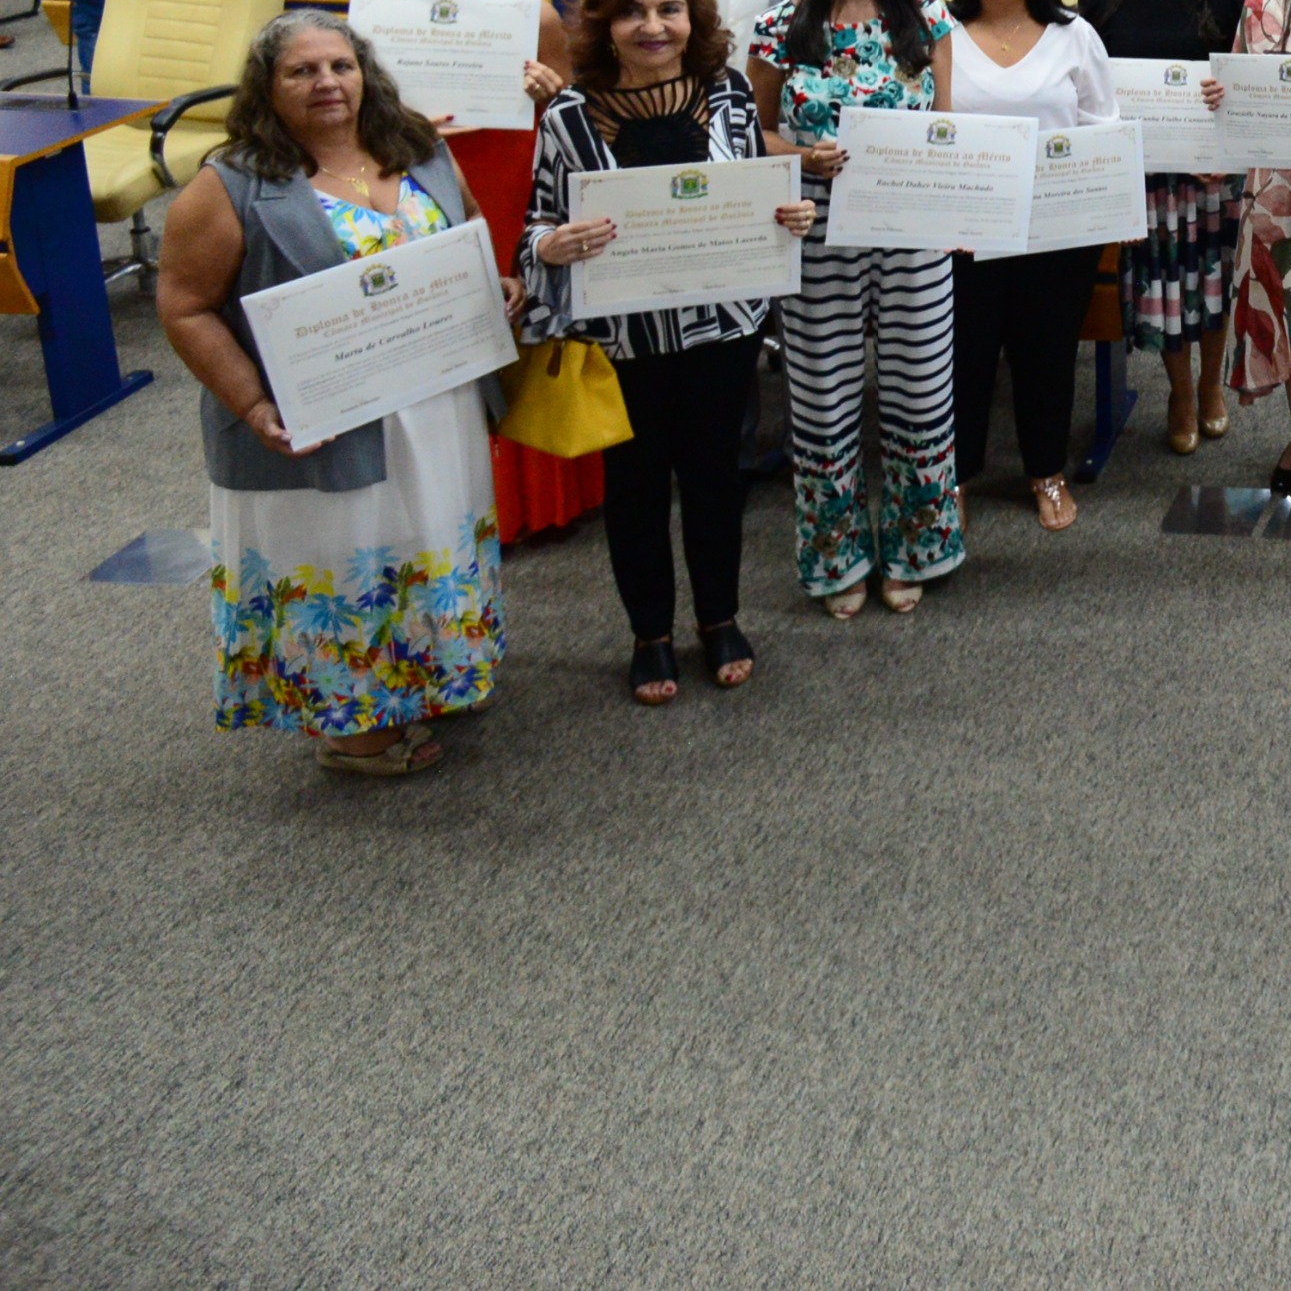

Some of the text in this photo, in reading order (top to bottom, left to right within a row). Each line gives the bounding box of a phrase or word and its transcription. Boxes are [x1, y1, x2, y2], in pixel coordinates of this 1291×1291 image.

[1116, 87, 1152, 97] Diploma
[1164, 88, 1188, 97] Honra
[1232, 83, 1268, 93] Diploma
[865, 145, 908, 158] Diploma
[912, 148, 923, 157] de
[927, 148, 960, 159] Honra
[977, 151, 1012, 162] Mérito
[1048, 162, 1077, 170] Honra
[1092, 155, 1122, 166] Mérito
[958, 183, 994, 191] Machado
[294, 313, 350, 339] Diploma
[352, 306, 364, 319] de
[370, 292, 408, 314] Honra
[414, 286, 426, 297] ao
[430, 269, 470, 293] Mérito
[334, 347, 363, 362] Maria
[366, 341, 376, 351] de
